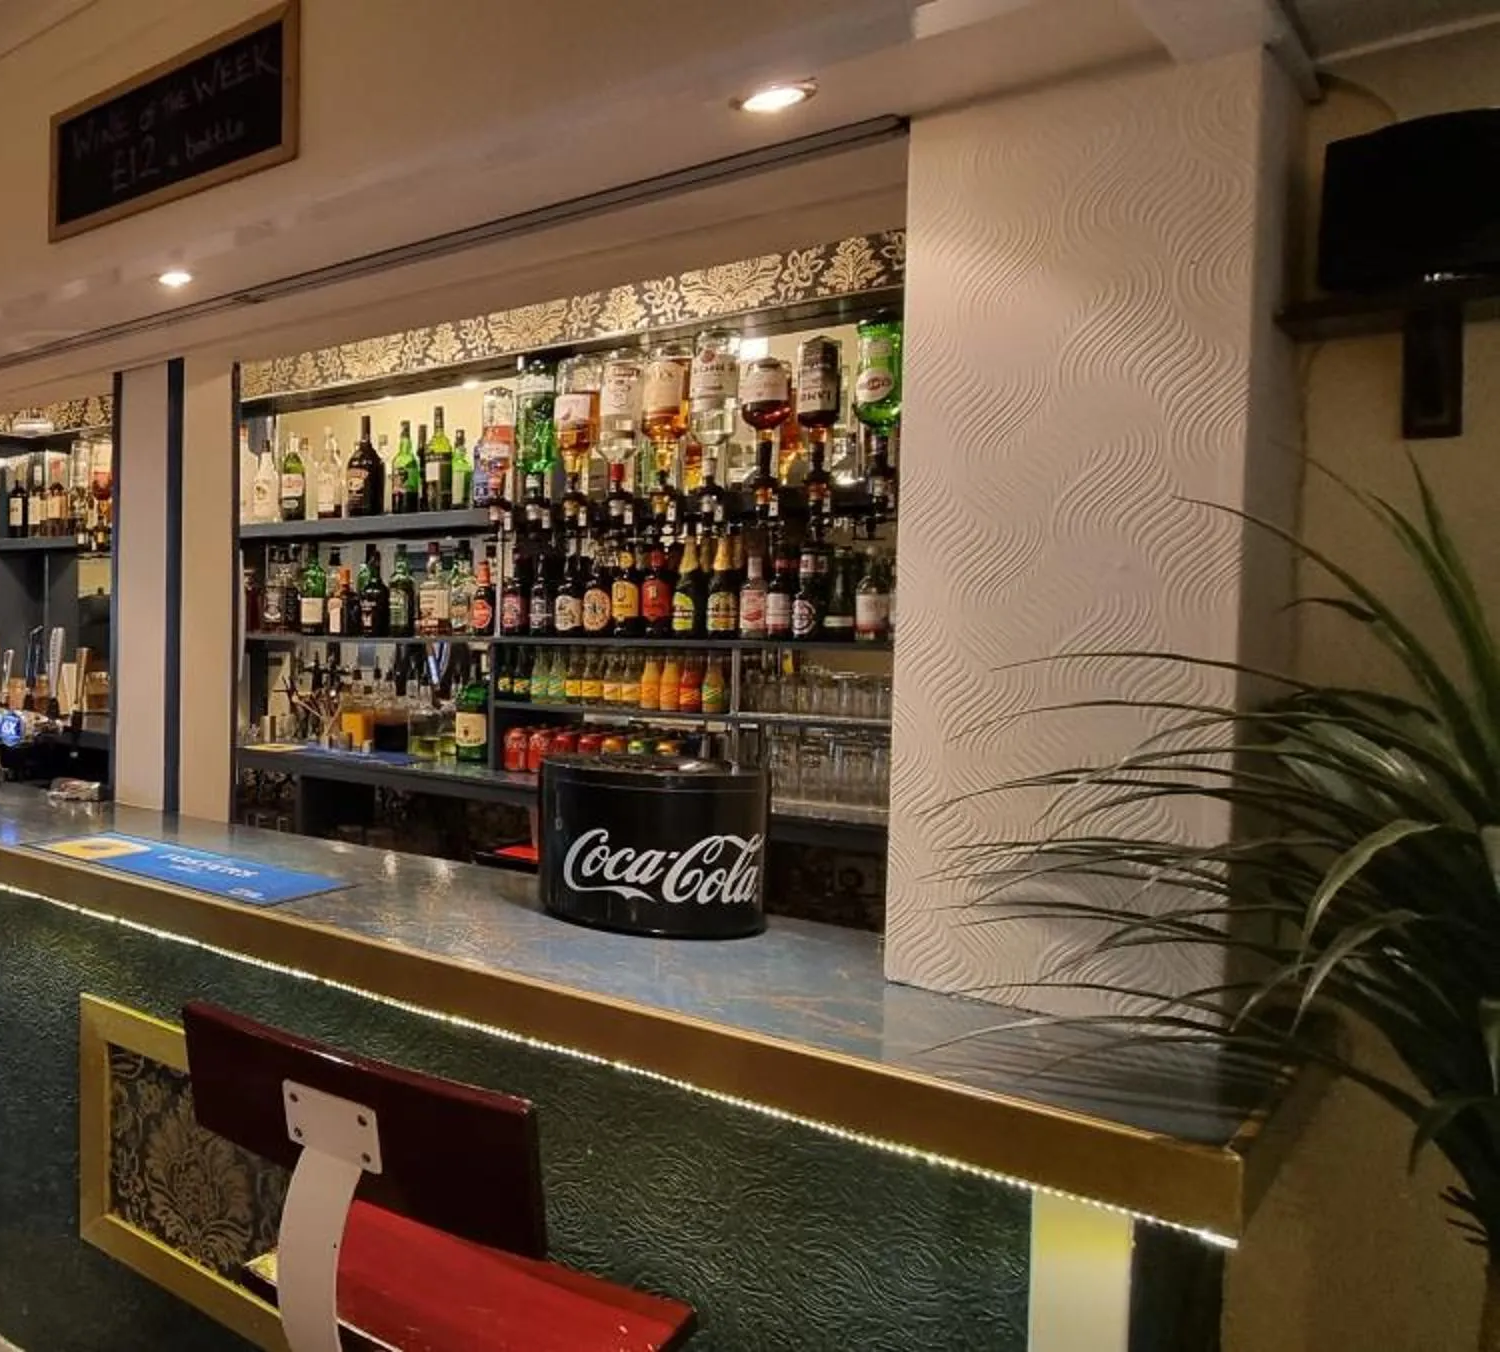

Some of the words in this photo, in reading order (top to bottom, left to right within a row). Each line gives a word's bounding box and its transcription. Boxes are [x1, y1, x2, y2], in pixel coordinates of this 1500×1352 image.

[191, 43, 281, 103] WEEK
[185, 118, 246, 163] bottle
[563, 828, 766, 905] Coca-Cola
